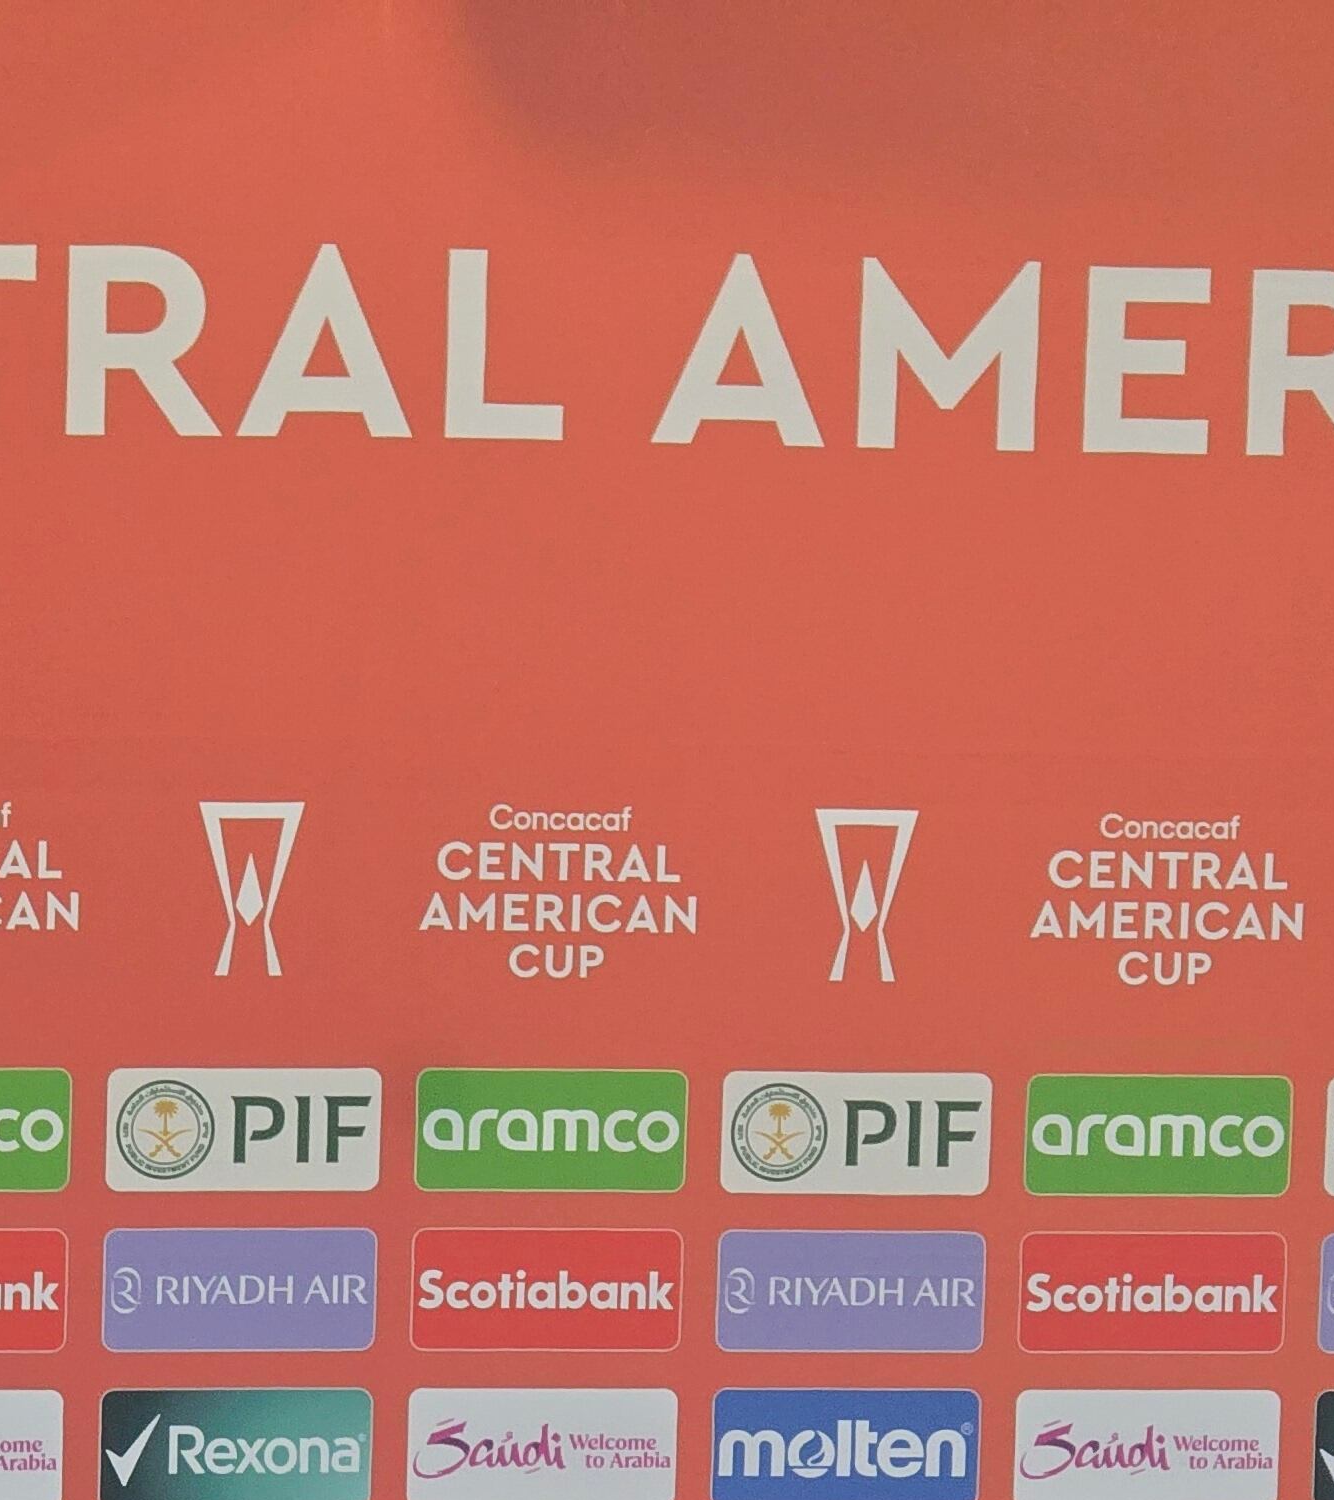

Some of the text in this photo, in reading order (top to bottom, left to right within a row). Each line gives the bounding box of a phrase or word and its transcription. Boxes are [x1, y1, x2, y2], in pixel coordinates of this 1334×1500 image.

[490, 804, 631, 831] Concacaf
[1101, 813, 1240, 839] Concacaf
[438, 841, 680, 882] CENTRAL
[1048, 850, 1287, 890] CENTRAL
[420, 893, 697, 933] AMERICAN
[1031, 901, 1303, 940] AMERICAN
[509, 944, 604, 978] CUP
[1118, 951, 1211, 985] CUP
[232, 1096, 372, 1163] PIF
[423, 1109, 679, 1152] aramco
[844, 1100, 982, 1167] PIF
[1032, 1114, 1284, 1157] aramco
[157, 1275, 367, 1304] RIYADH AIR
[419, 1270, 673, 1309] Scotiabank
[769, 1277, 975, 1306] RIYADH AIR
[1027, 1273, 1277, 1312] Scotiabank
[168, 1425, 360, 1475] Rexona
[718, 1420, 966, 1478] molten
